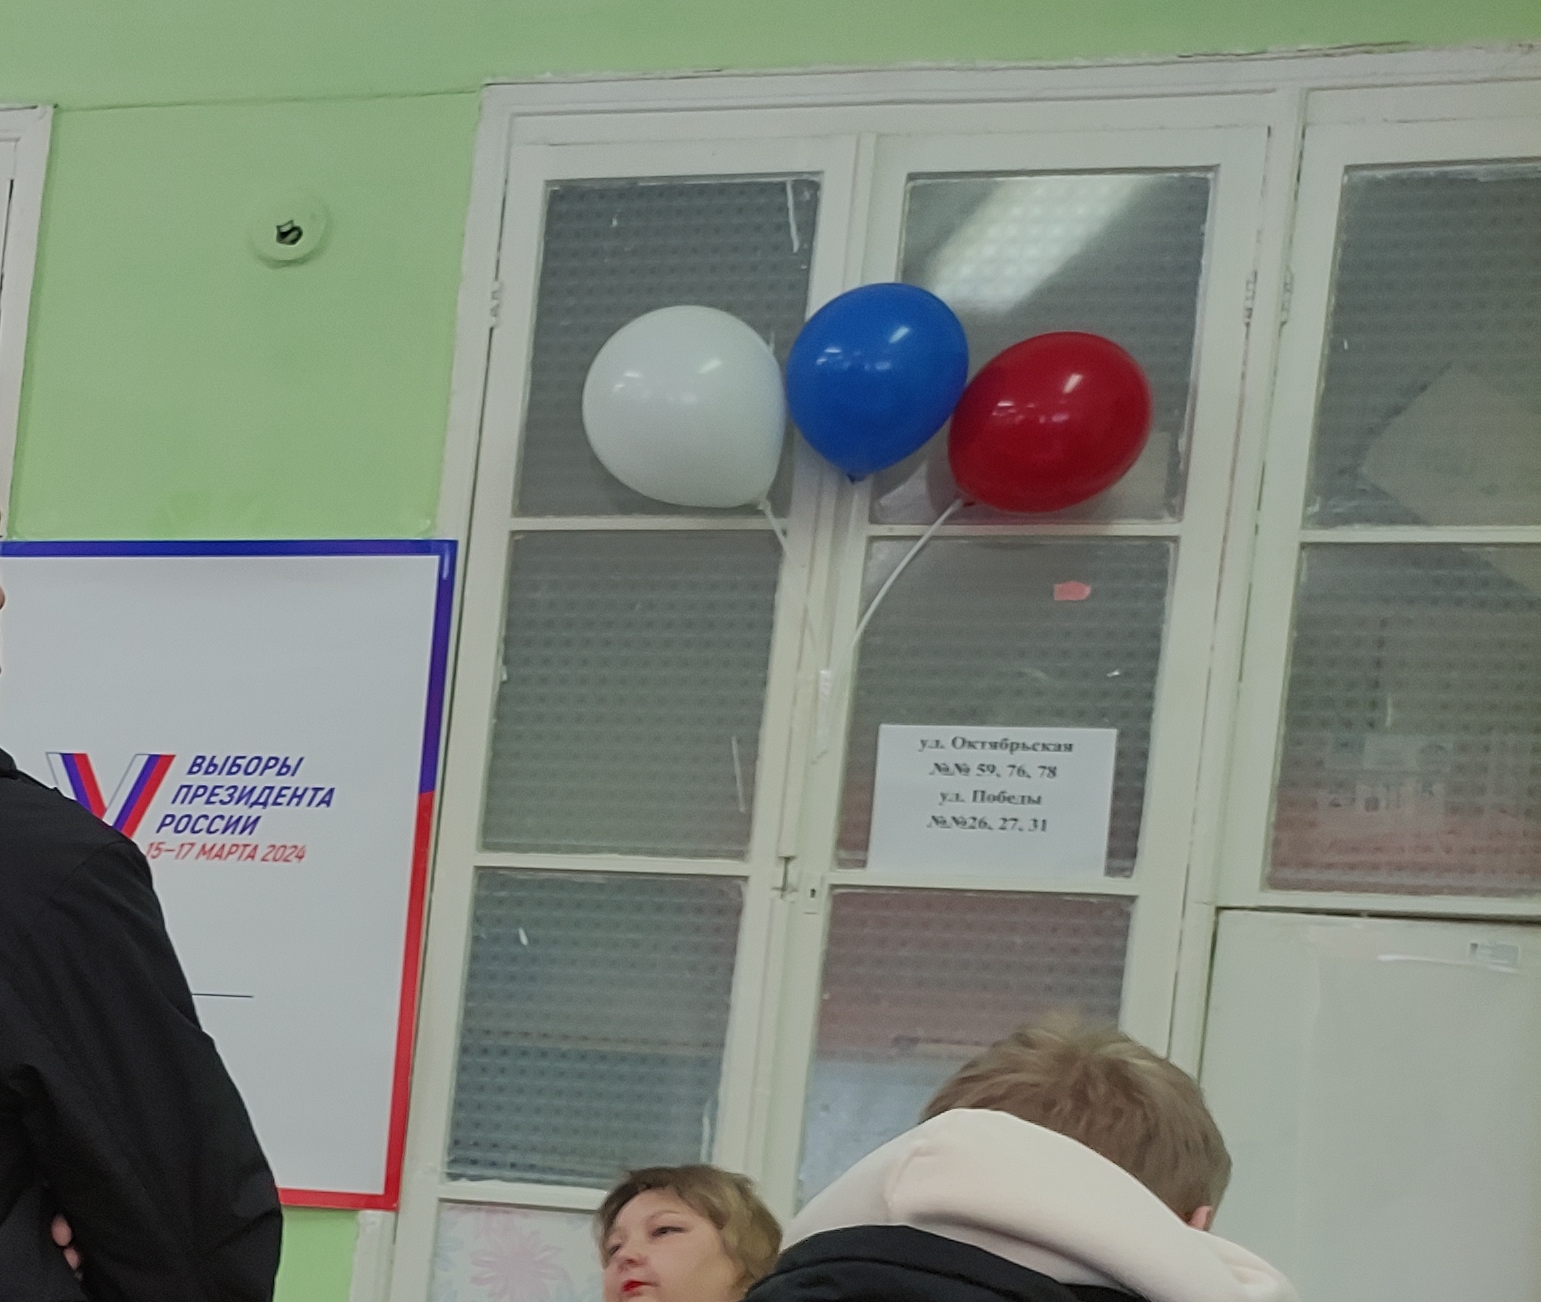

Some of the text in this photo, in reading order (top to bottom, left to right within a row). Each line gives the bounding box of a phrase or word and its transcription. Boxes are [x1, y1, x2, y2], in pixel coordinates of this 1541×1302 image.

[918, 735, 1074, 755] ул. Октябрьская
[186, 755, 305, 777] ВЫБОРЫ
[1037, 765, 1058, 779] 78
[171, 784, 336, 810] ПРЕЗИДЕНТА
[938, 789, 1043, 806] ул. Победы
[156, 813, 262, 836] РОССИИ
[1028, 818, 1048, 832] 31
[195, 842, 259, 862] МАРТА
[261, 844, 307, 864] 2024
